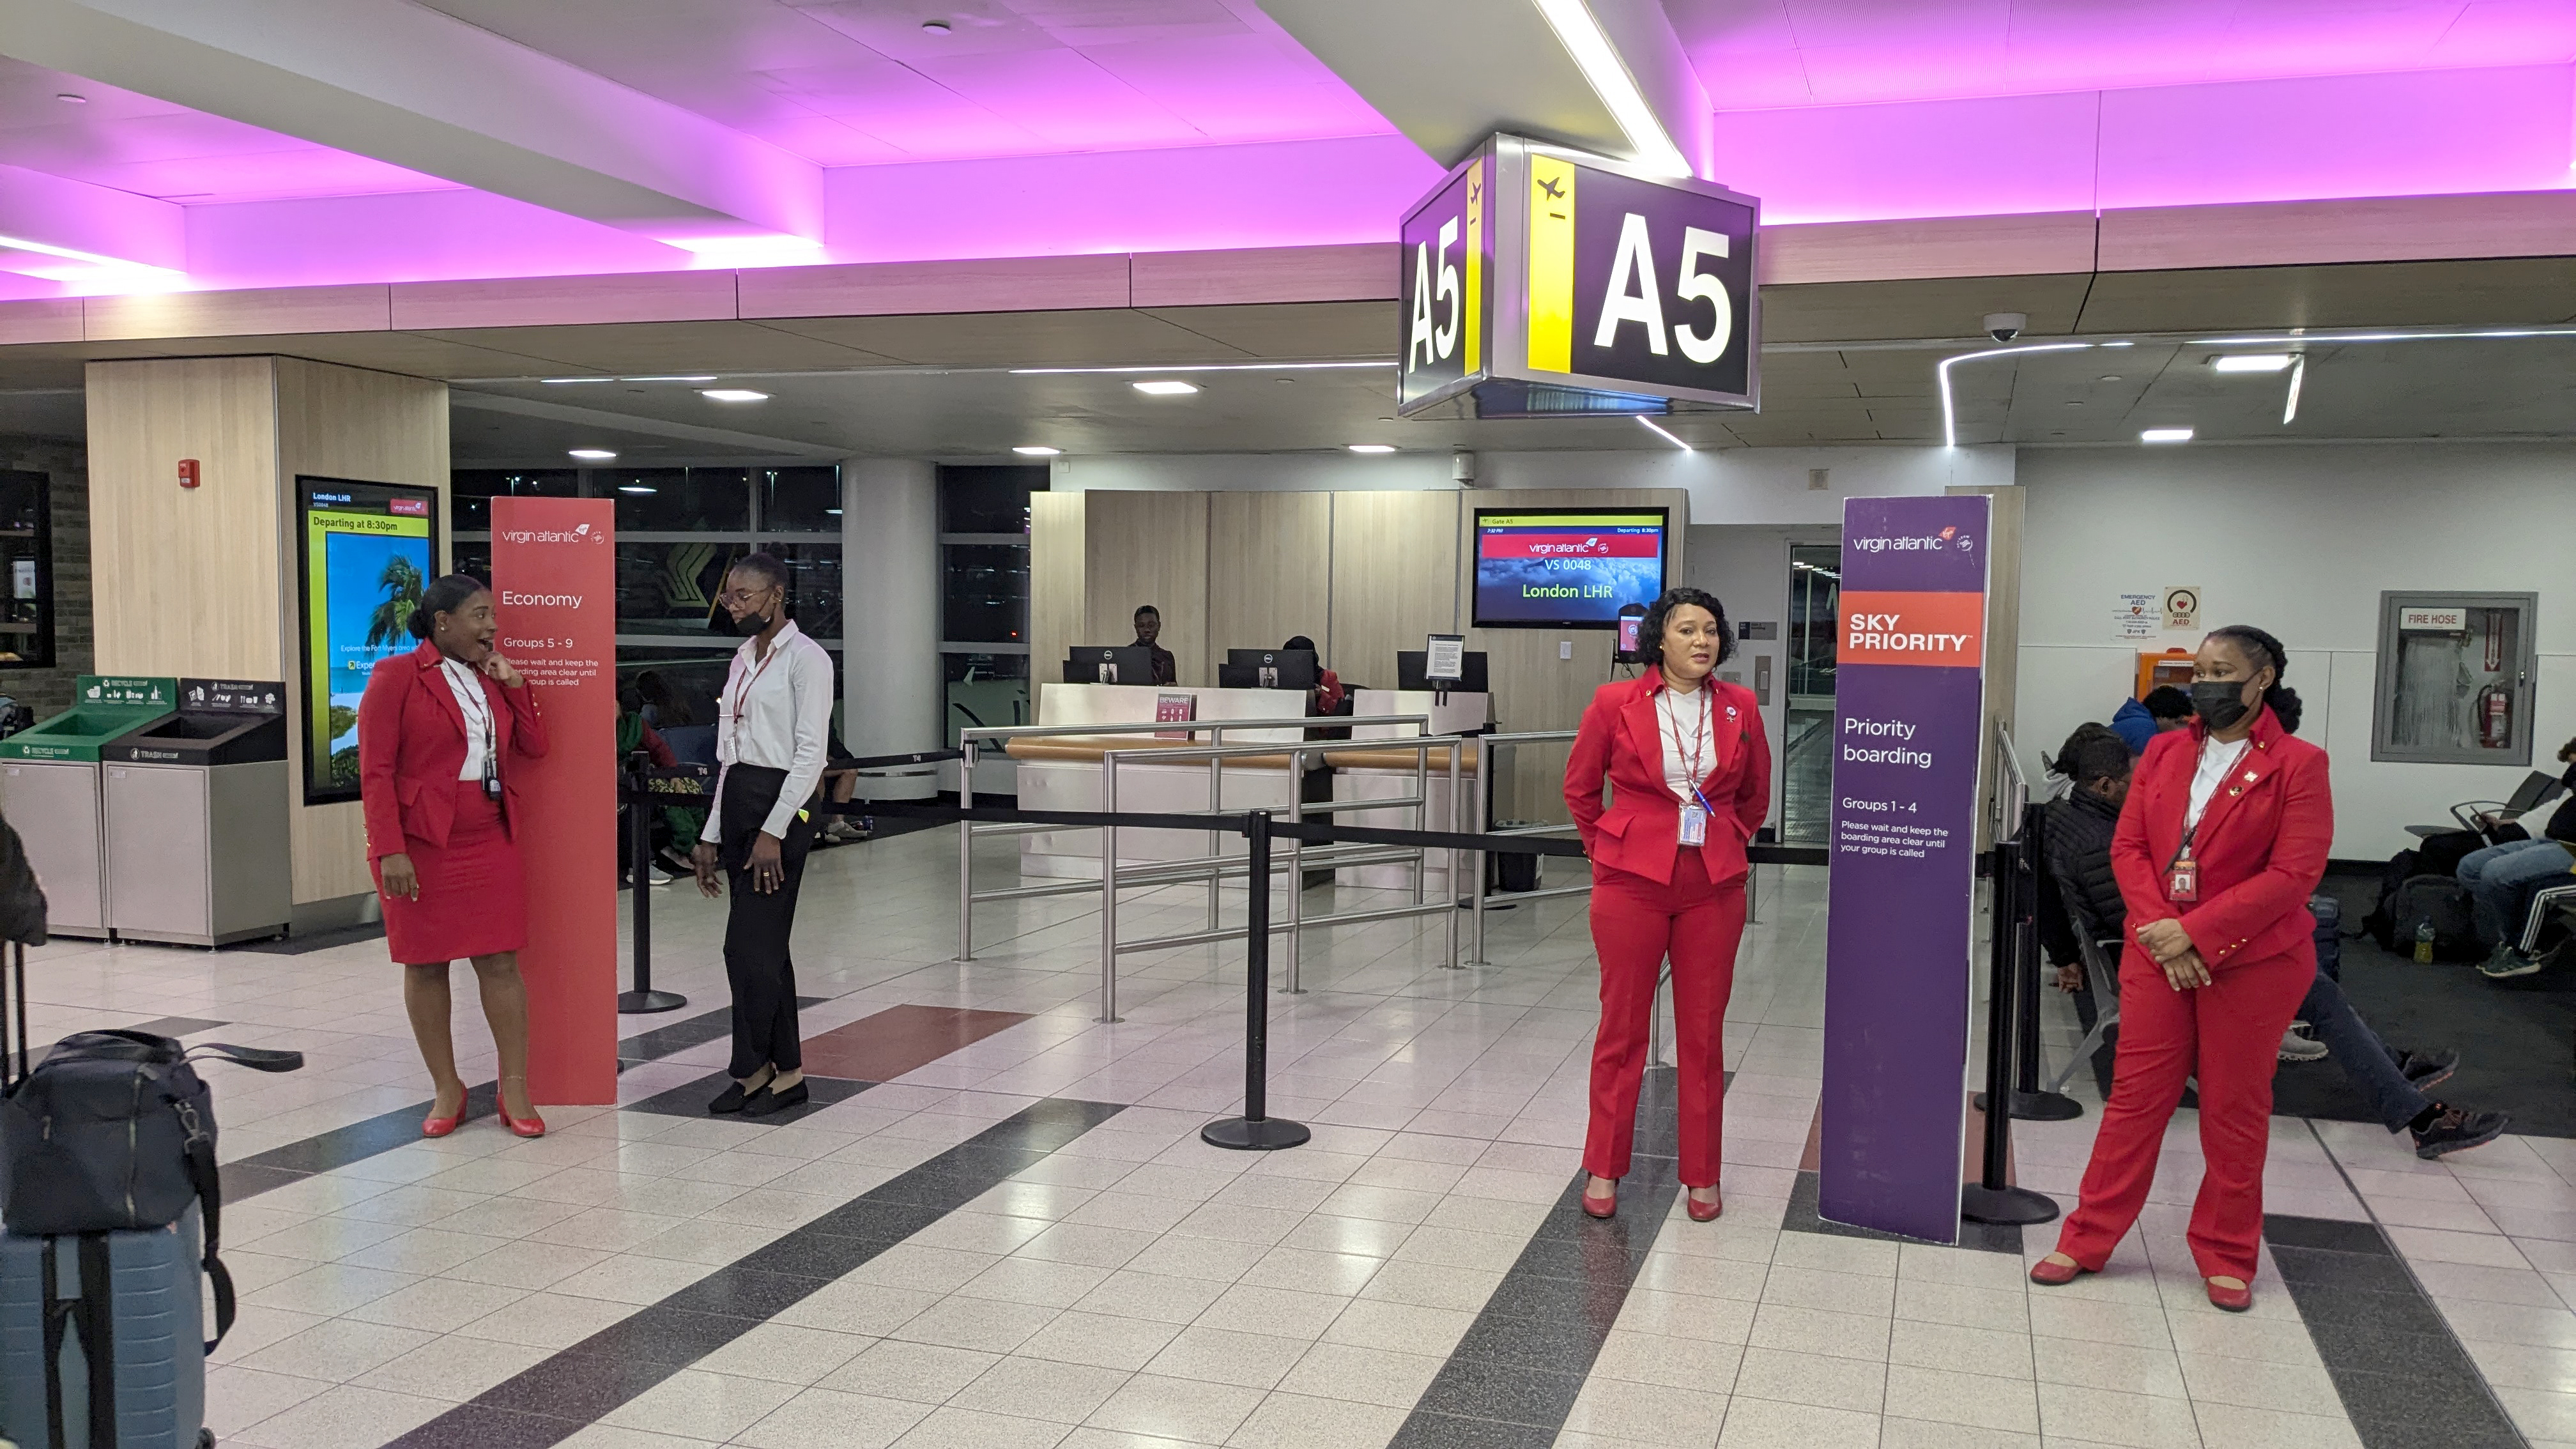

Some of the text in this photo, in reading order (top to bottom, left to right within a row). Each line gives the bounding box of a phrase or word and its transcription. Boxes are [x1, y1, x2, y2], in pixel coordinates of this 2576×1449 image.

[1408, 215, 1460, 375] A5
[1594, 212, 1732, 364] A5
[312, 493, 337, 501] London
[313, 516, 398, 532] Departing at 8:30pm
[502, 530, 535, 544] virgin
[537, 530, 579, 542] atlantic
[1853, 536, 1891, 553] virgin
[1893, 536, 1943, 550] atlantic
[1529, 543, 1555, 555] virgin
[1556, 543, 1589, 553] atlantic
[1544, 559, 1591, 571] VS 0048
[1522, 584, 1613, 598] London LHR
[502, 590, 583, 609] Economy
[1850, 613, 1900, 631] SKY
[2408, 614, 2457, 624] FIRE HOSE
[503, 637, 544, 649] Groups
[548, 638, 555, 648] 5
[565, 638, 573, 648] 9
[1849, 632, 1968, 652] PRIORITY
[565, 659, 584, 668] keep
[1844, 717, 1916, 740] Priority
[1844, 744, 1932, 769] boarding
[698, 767, 708, 776] T4
[1842, 797, 1888, 812] Groups
[1890, 801, 1896, 812] 1
[1908, 802, 1917, 813] 4
[1841, 820, 1949, 836] Please wait and keep the
[1841, 832, 1945, 848] boarding area clear until
[1840, 844, 1924, 858] your group is called
